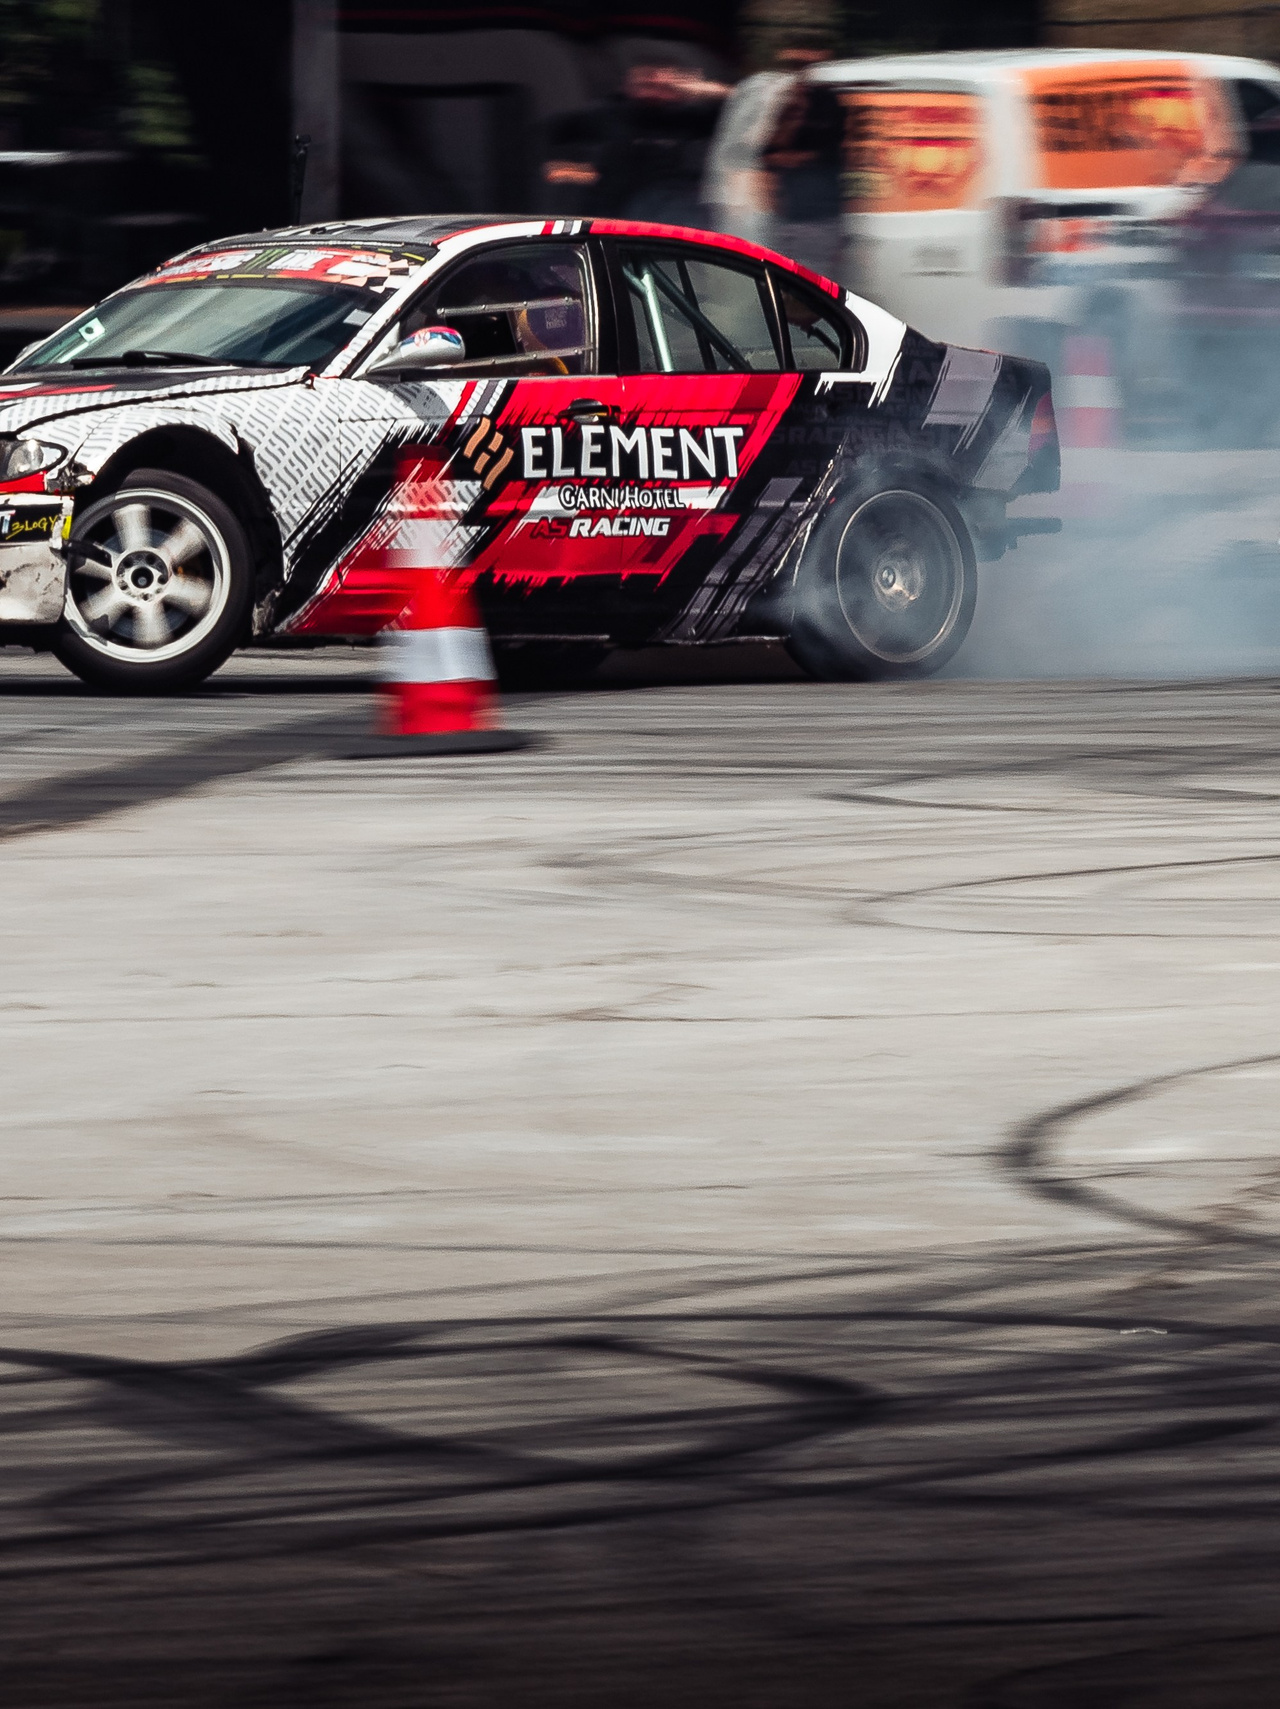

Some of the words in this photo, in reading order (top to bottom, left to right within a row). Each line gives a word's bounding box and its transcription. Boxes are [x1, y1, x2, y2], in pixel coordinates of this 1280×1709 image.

[521, 425, 743, 479] ELEMENT
[560, 485, 620, 508] GARNI
[569, 517, 671, 537] RACING
